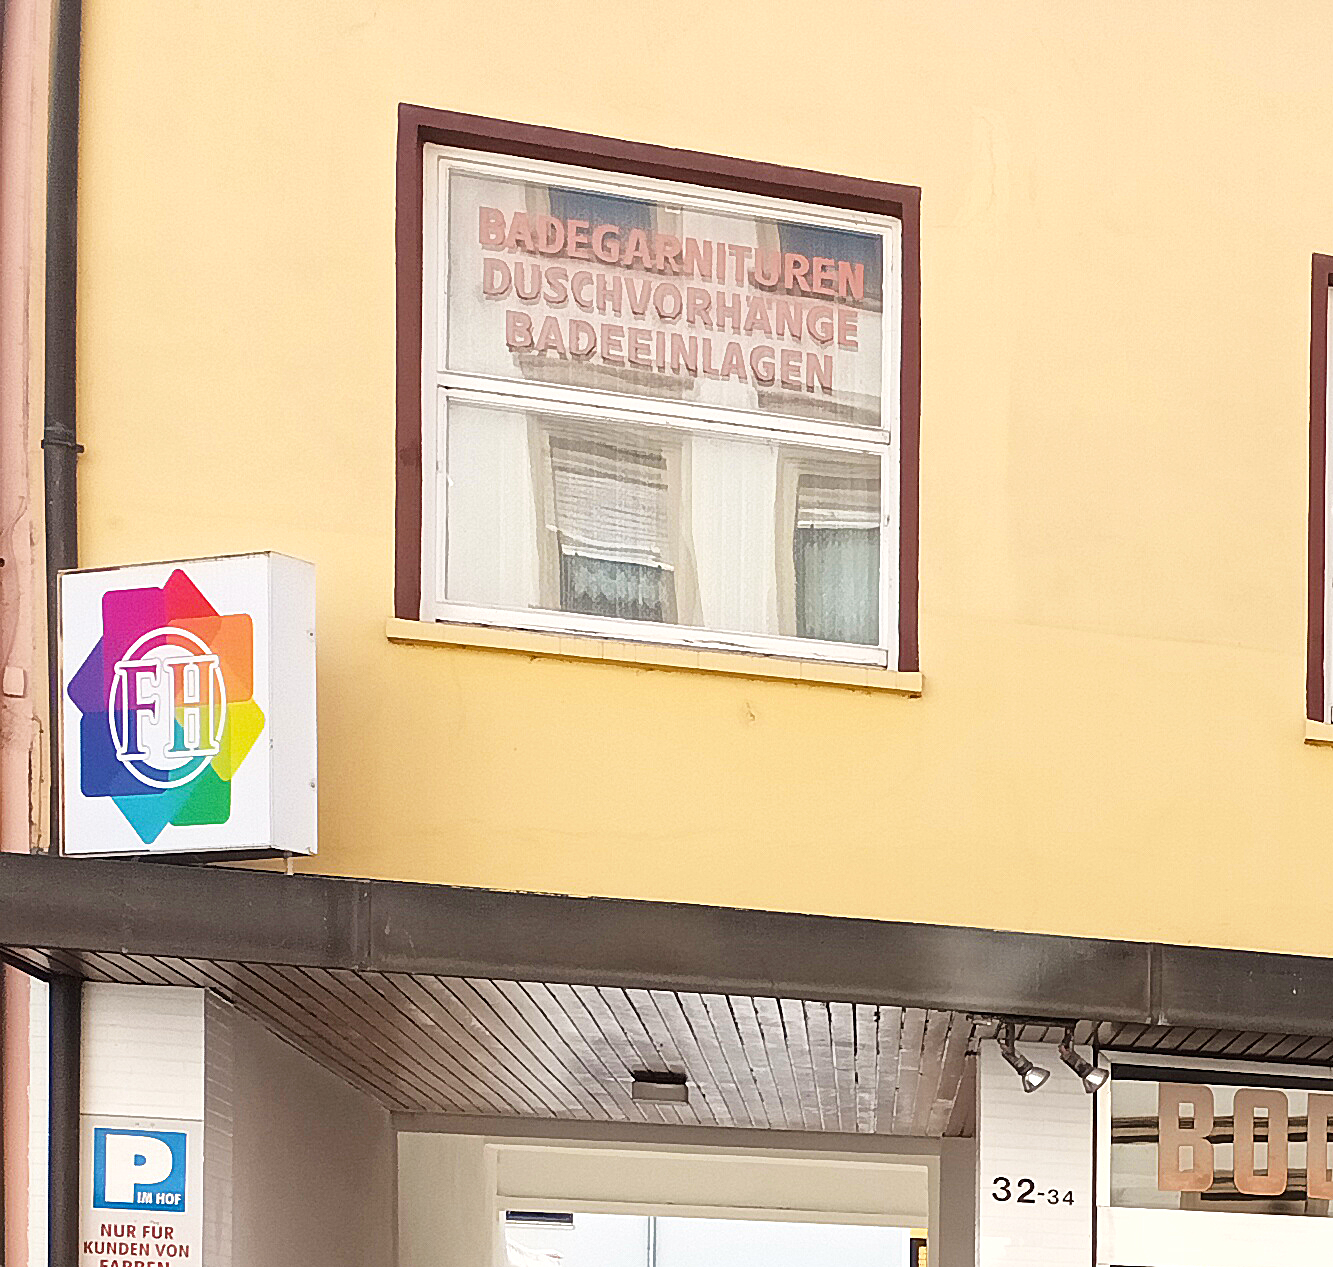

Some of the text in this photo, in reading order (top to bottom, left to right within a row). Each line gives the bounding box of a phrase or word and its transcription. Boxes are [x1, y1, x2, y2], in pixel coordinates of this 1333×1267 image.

[479, 206, 865, 300] BADEGARNITUREN
[506, 309, 833, 392] BADEEINLAGEN
[115, 654, 219, 761] FH
[104, 1133, 174, 1204] P
[991, 1176, 1075, 1206] 32-34
[137, 1192, 182, 1205] IM HOF
[83, 1240, 190, 1258] KUNDEN VON
[100, 1223, 137, 1239] NUR
